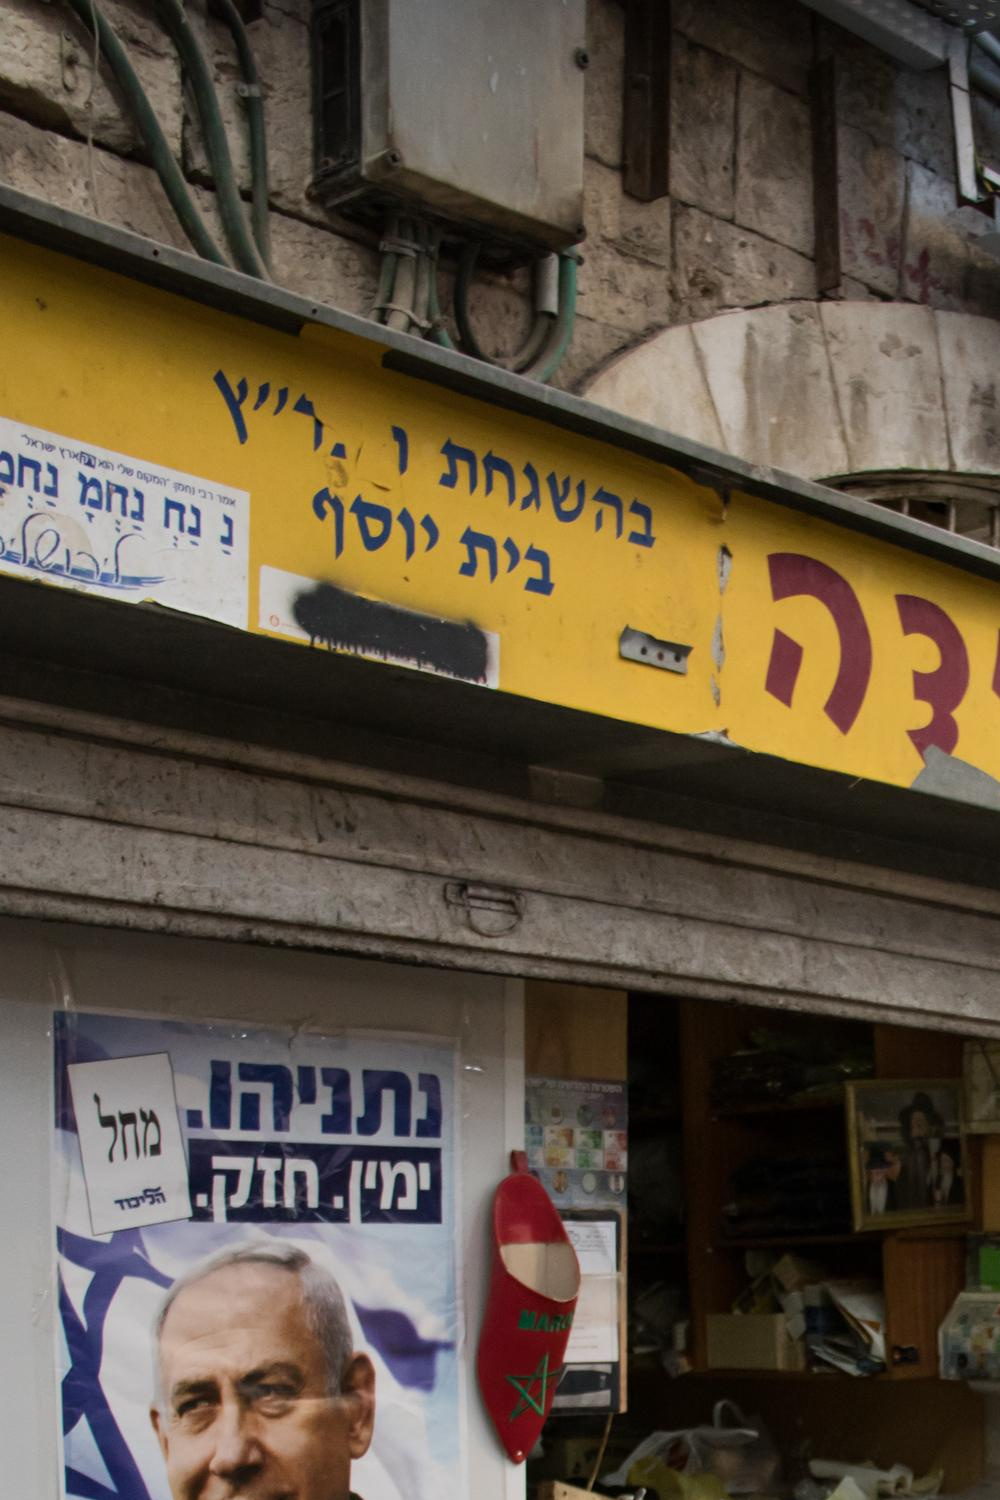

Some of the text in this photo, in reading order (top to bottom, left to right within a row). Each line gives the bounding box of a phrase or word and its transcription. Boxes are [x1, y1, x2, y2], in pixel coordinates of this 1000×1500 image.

[98, 458, 114, 471] הוא
[117, 463, 134, 477] שלי
[198, 489, 214, 500] רבי
[216, 494, 237, 507] אמר
[439, 437, 656, 548] בהשגחת
[312, 487, 555, 596] בית יוסף
[186, 1060, 442, 1138] נתניהו.
[93, 1092, 162, 1163] מחל
[114, 1186, 167, 1211] הליכוד
[196, 1156, 430, 1224] ימין. חזק.
